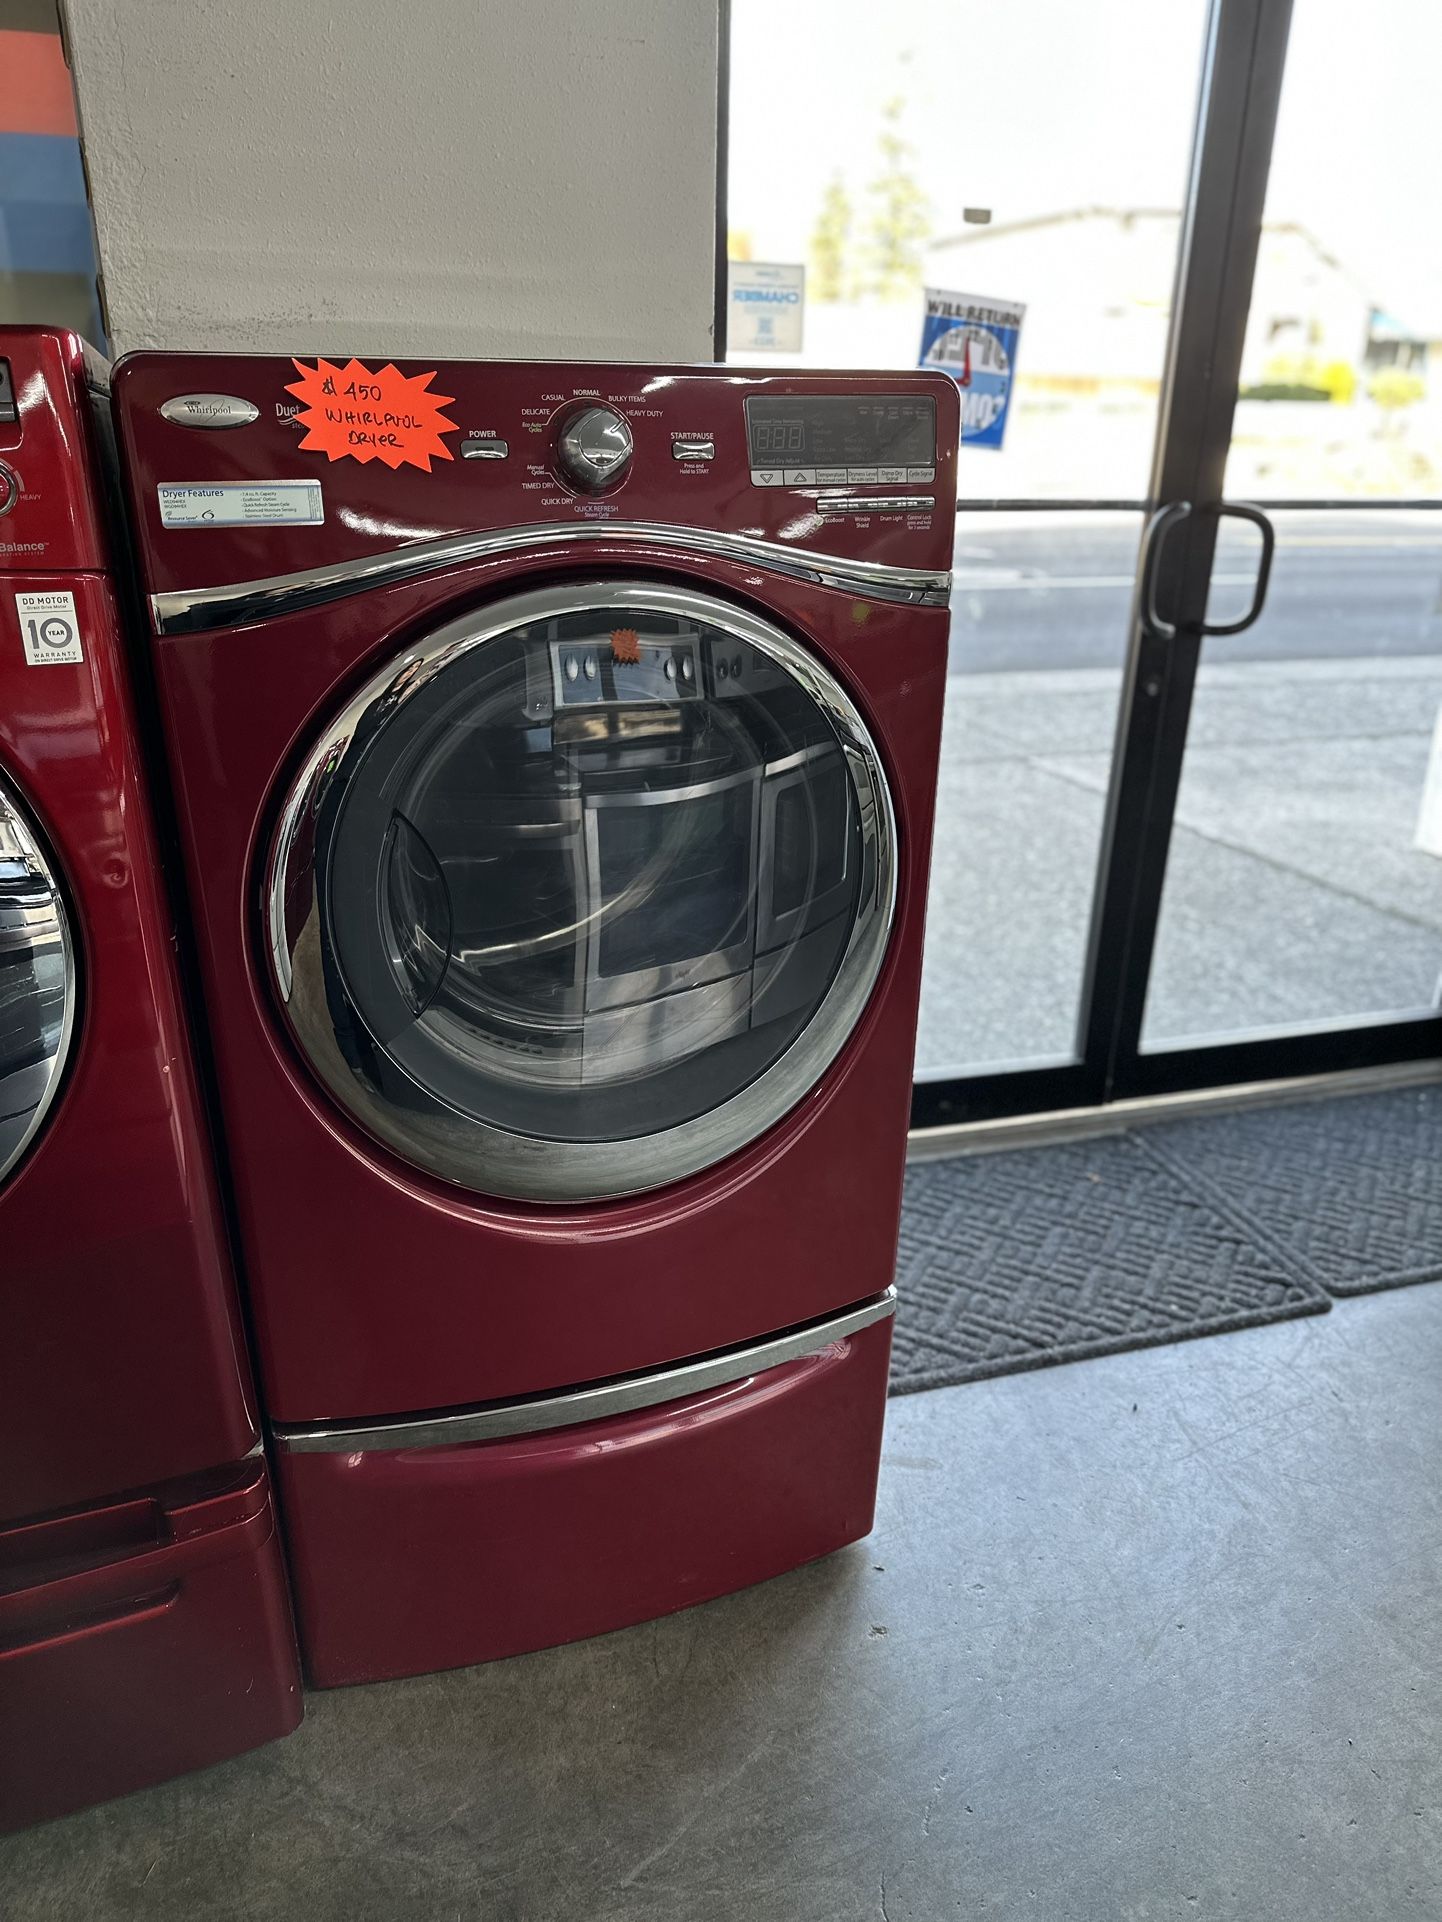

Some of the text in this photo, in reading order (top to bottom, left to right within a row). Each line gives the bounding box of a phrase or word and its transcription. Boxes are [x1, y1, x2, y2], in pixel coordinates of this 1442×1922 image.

[927, 300, 1020, 326] WILL RETURN
[186, 406, 231, 416] Whirlpool
[276, 403, 300, 416] Duet
[162, 490, 186, 499] Dryer
[38, 596, 68, 604] MOTOR
[28, 618, 72, 649] 10
